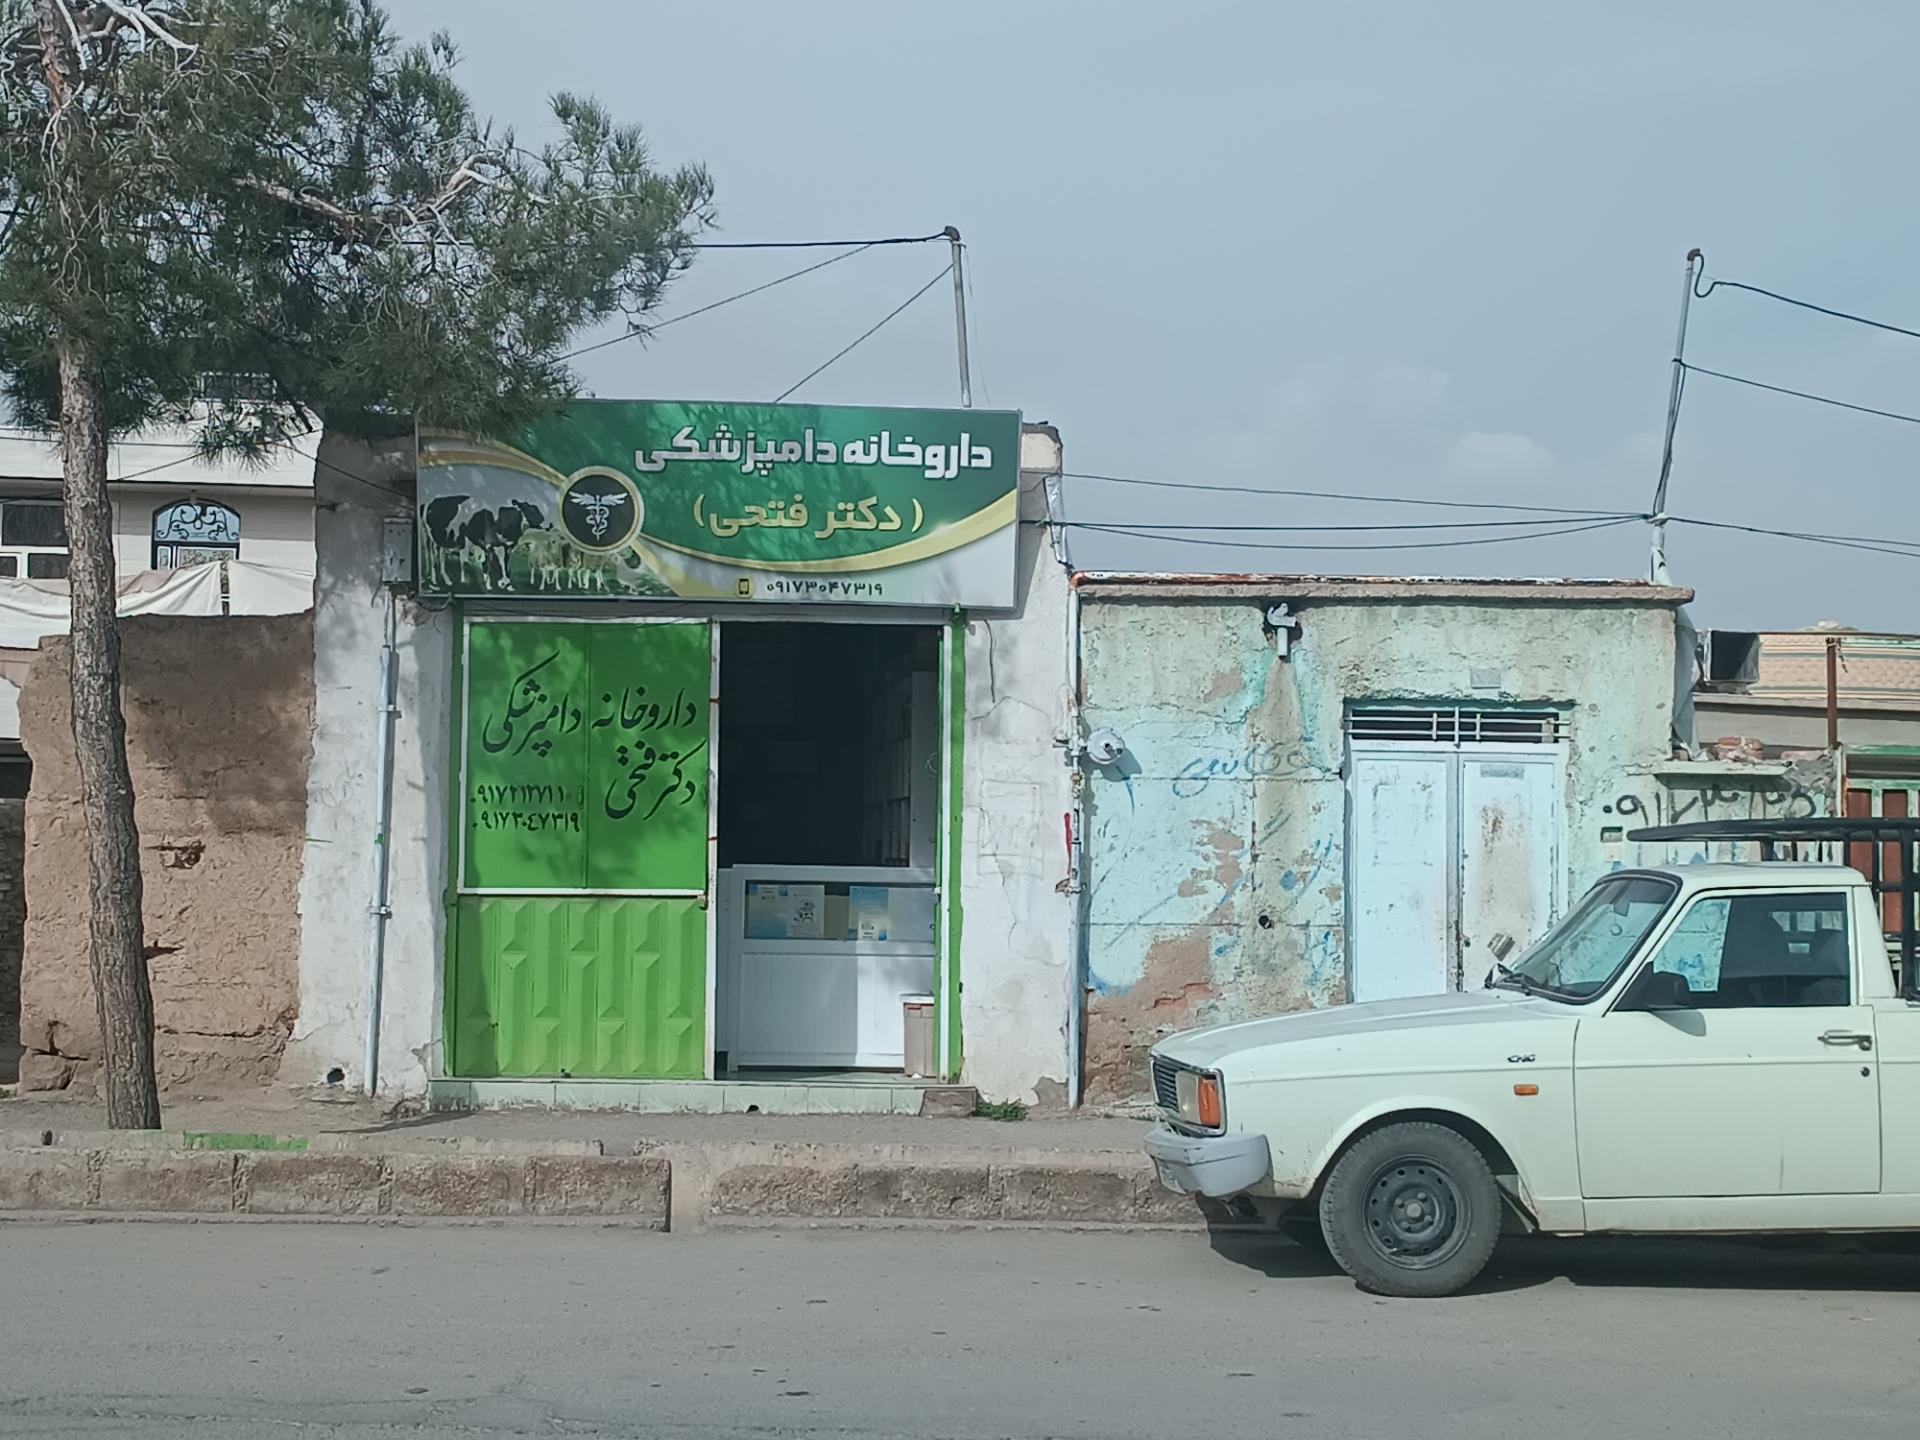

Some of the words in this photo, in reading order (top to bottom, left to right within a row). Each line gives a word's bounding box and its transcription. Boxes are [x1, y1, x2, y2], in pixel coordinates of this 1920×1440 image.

[634, 424, 838, 476] دامپزشکی
[843, 430, 992, 479] داروخانه
[766, 580, 883, 596] ۰۹۱۷۳۰۴۷۳۱۹
[482, 651, 582, 756] دامپزشکی
[591, 686, 697, 732] داروخانه
[605, 740, 656, 820] فتحی
[643, 738, 707, 820] دکتر
